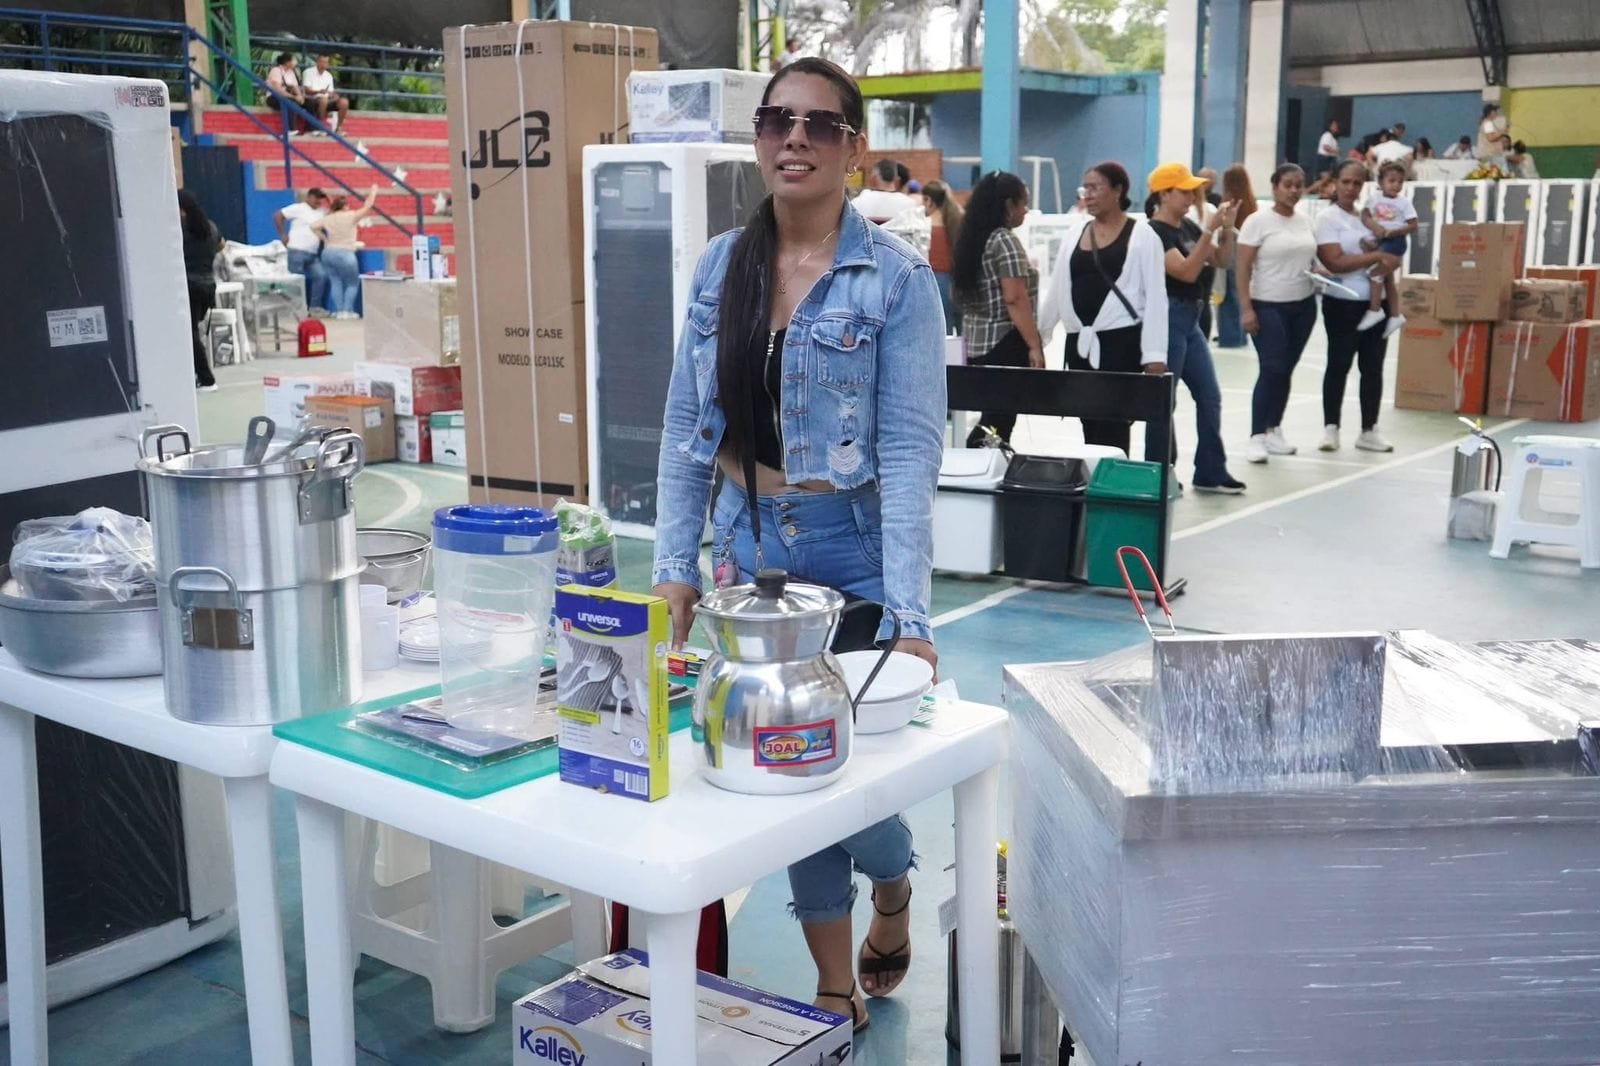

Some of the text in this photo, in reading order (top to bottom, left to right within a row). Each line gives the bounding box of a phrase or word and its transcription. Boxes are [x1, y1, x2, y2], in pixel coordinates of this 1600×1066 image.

[536, 327, 563, 339] CASE
[765, 742, 801, 753] JOAL
[808, 1011, 835, 1023] OLLA
[797, 1029, 812, 1037] 5
